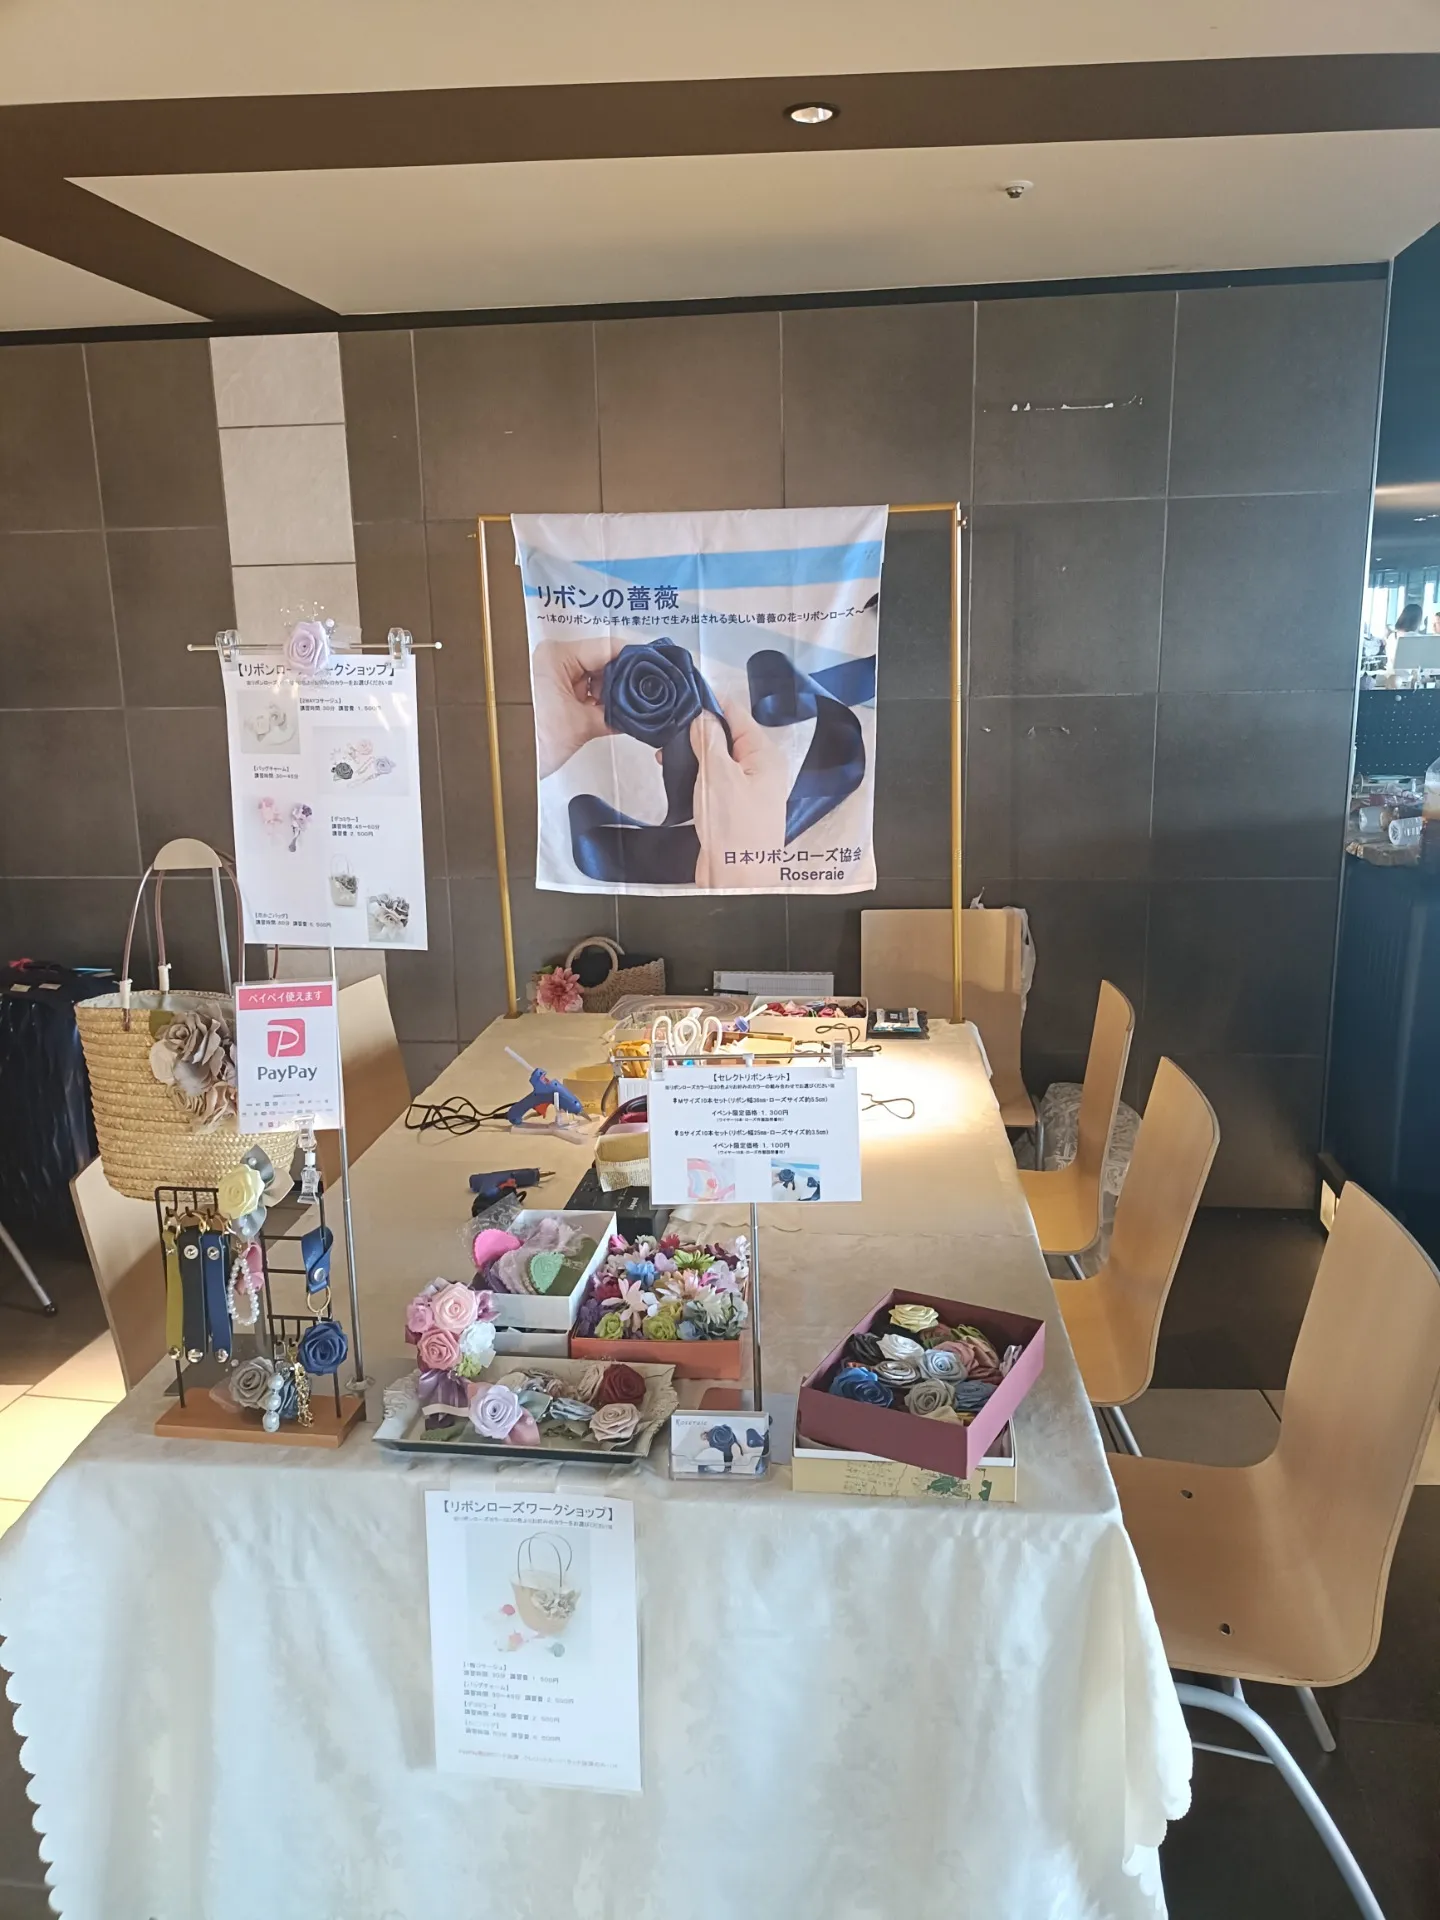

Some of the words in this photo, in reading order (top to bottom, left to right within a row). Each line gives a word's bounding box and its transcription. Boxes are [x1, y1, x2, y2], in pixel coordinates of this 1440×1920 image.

[537, 584, 679, 611] リボンの薔薇
[724, 847, 862, 864] 日本リボンローズ協会
[780, 867, 845, 881] Roseraie
[248, 990, 323, 1004] ペイペイ使えます
[257, 1065, 318, 1082] PayPay
[713, 1072, 790, 1082] 【セレクトリボンキット】
[443, 1500, 614, 1522] 【リボンローズワークショップ】
